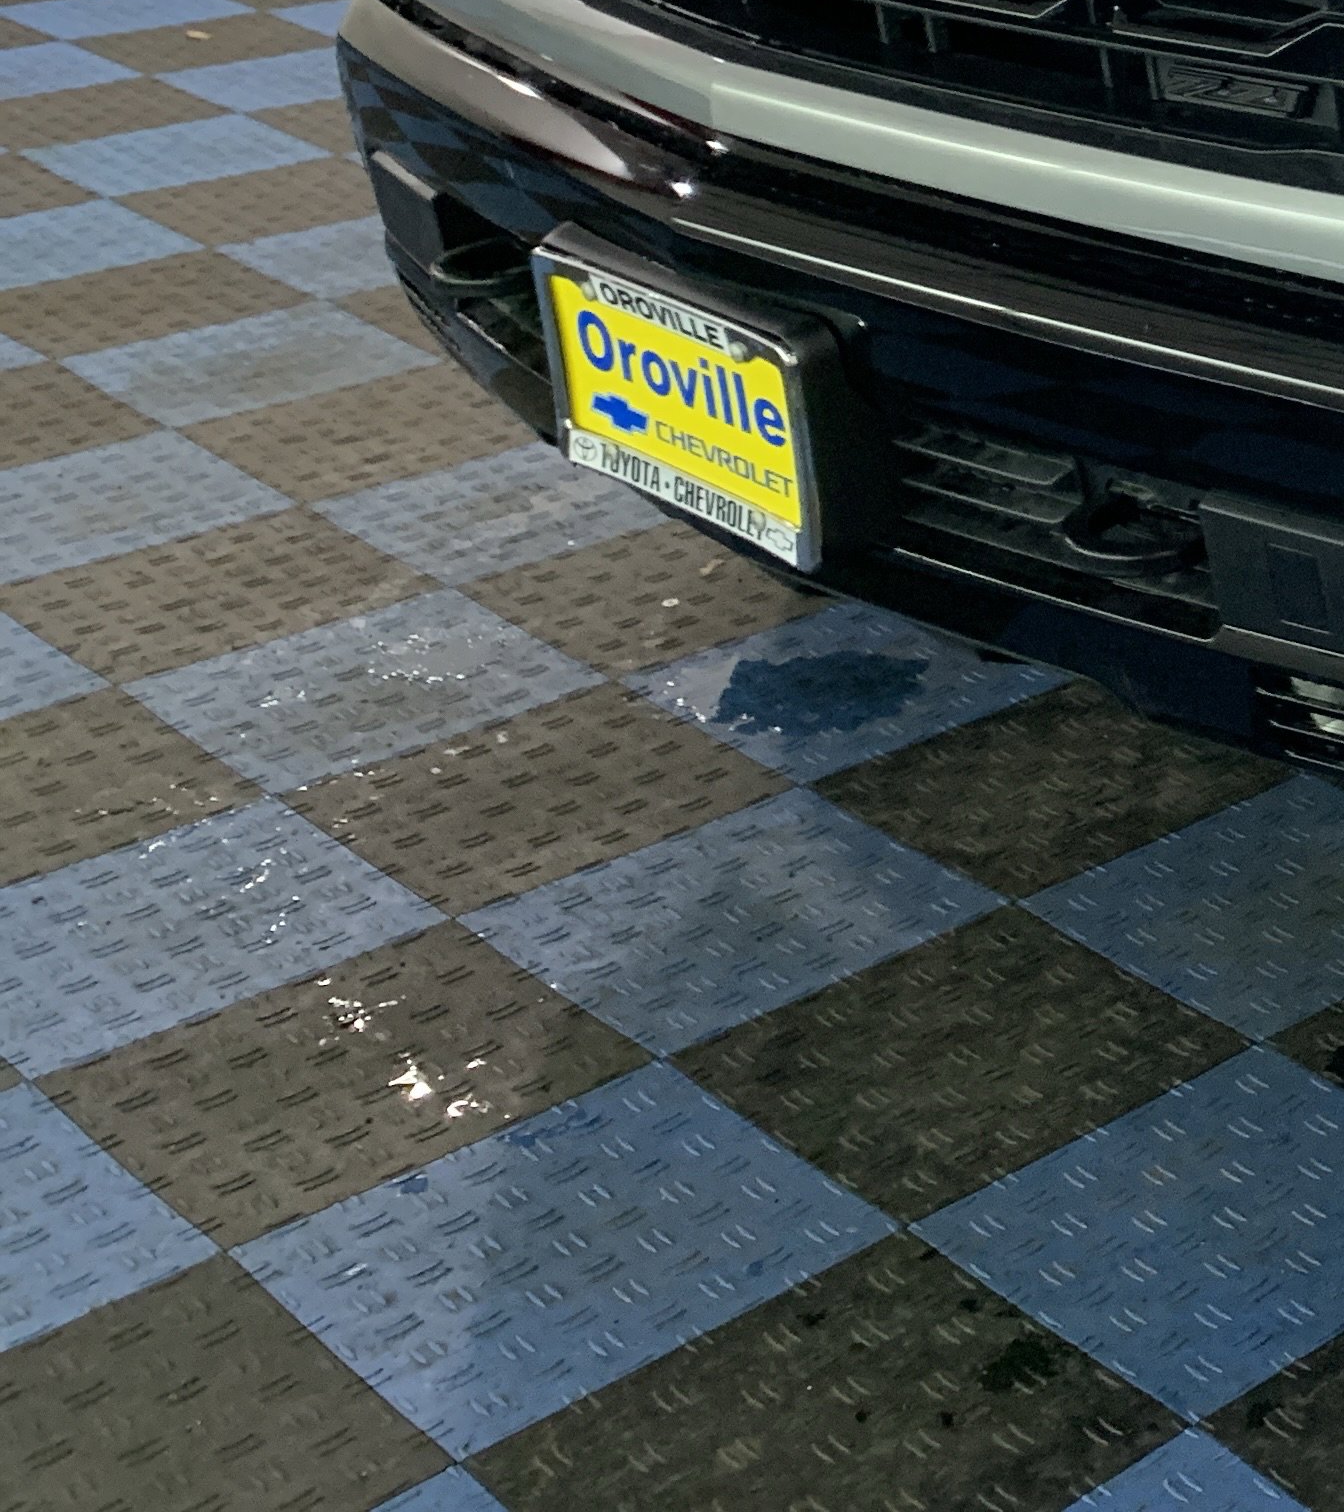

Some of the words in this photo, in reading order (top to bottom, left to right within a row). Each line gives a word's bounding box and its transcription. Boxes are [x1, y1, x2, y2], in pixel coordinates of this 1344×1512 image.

[600, 283, 722, 349] OROVILLE
[577, 310, 786, 447] Oroville
[656, 421, 793, 498] CHEVROLET
